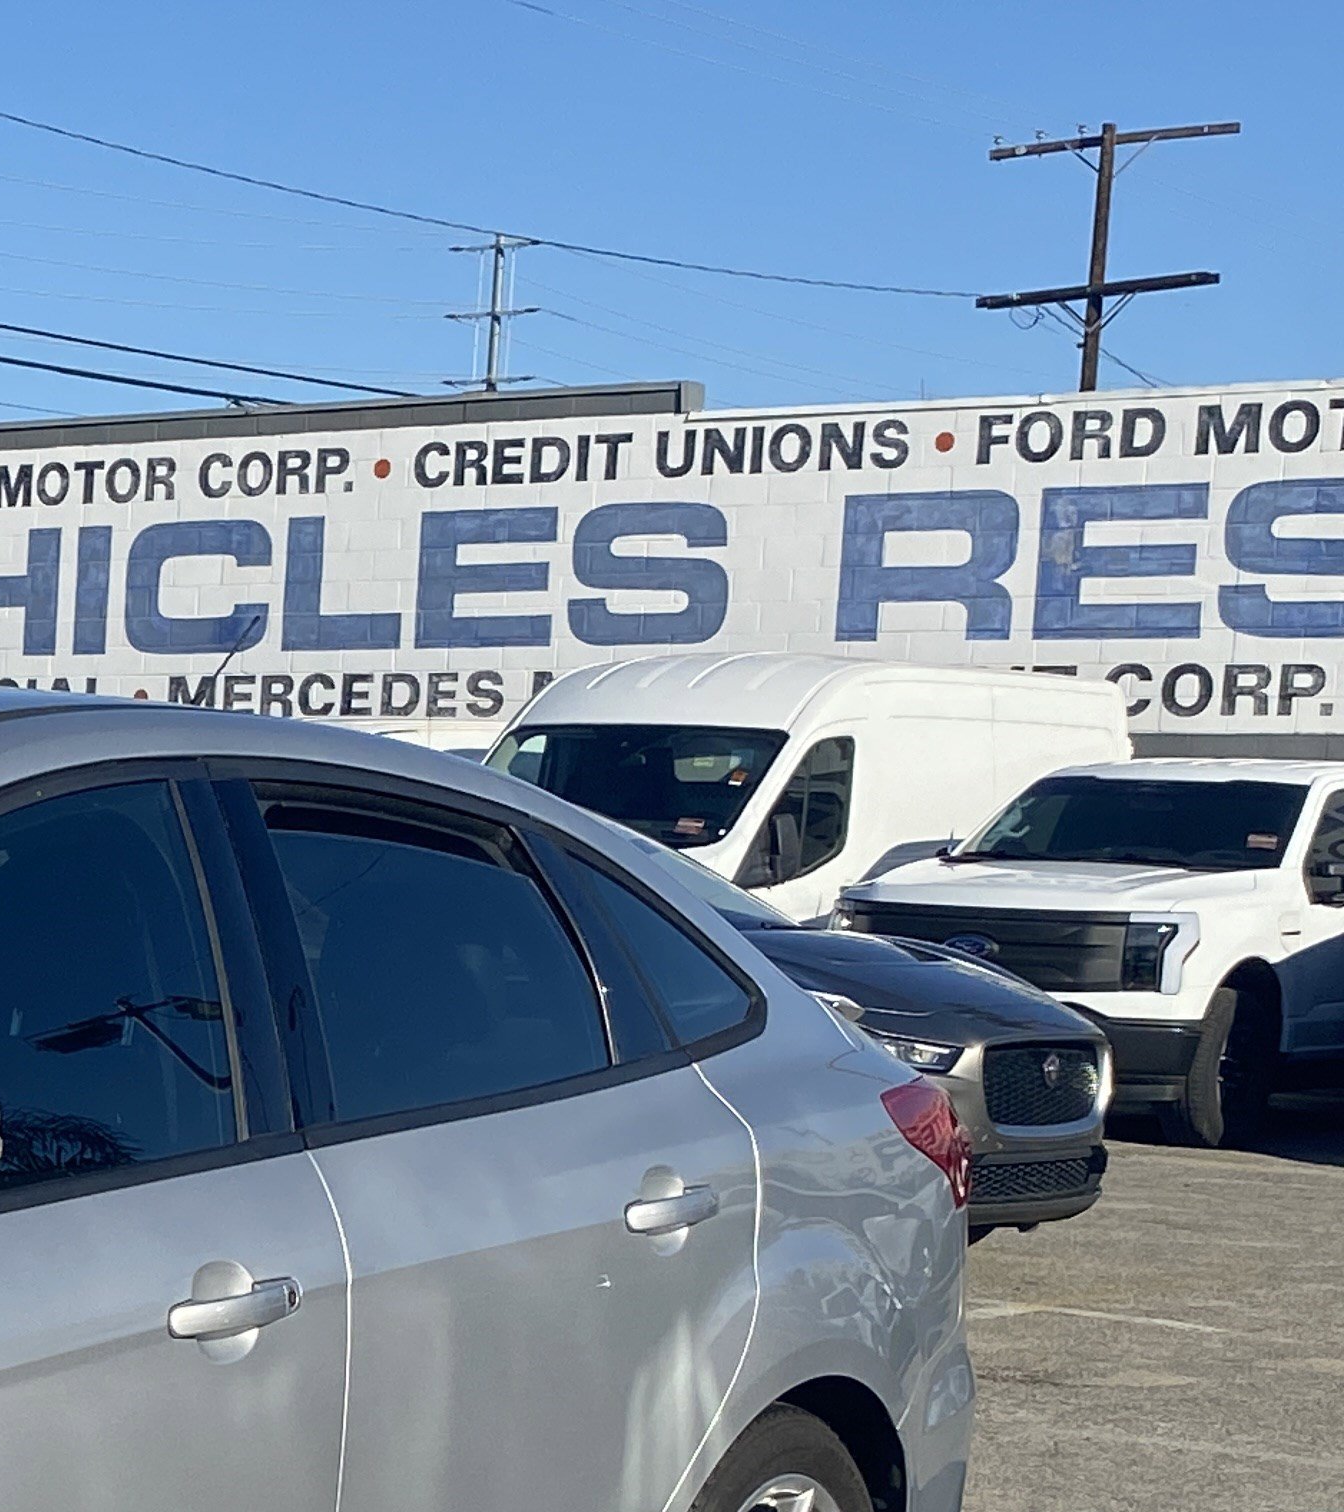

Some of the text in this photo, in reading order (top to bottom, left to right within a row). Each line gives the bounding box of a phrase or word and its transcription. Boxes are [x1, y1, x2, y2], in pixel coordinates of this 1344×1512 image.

[198, 447, 354, 498] CORP.
[414, 432, 634, 488] CREDIT
[655, 419, 910, 478] UNIONS
[975, 407, 1166, 465] FORD
[834, 478, 1344, 642] RES
[168, 670, 505, 718] MERCEDES
[1104, 662, 1334, 717] CORP.
